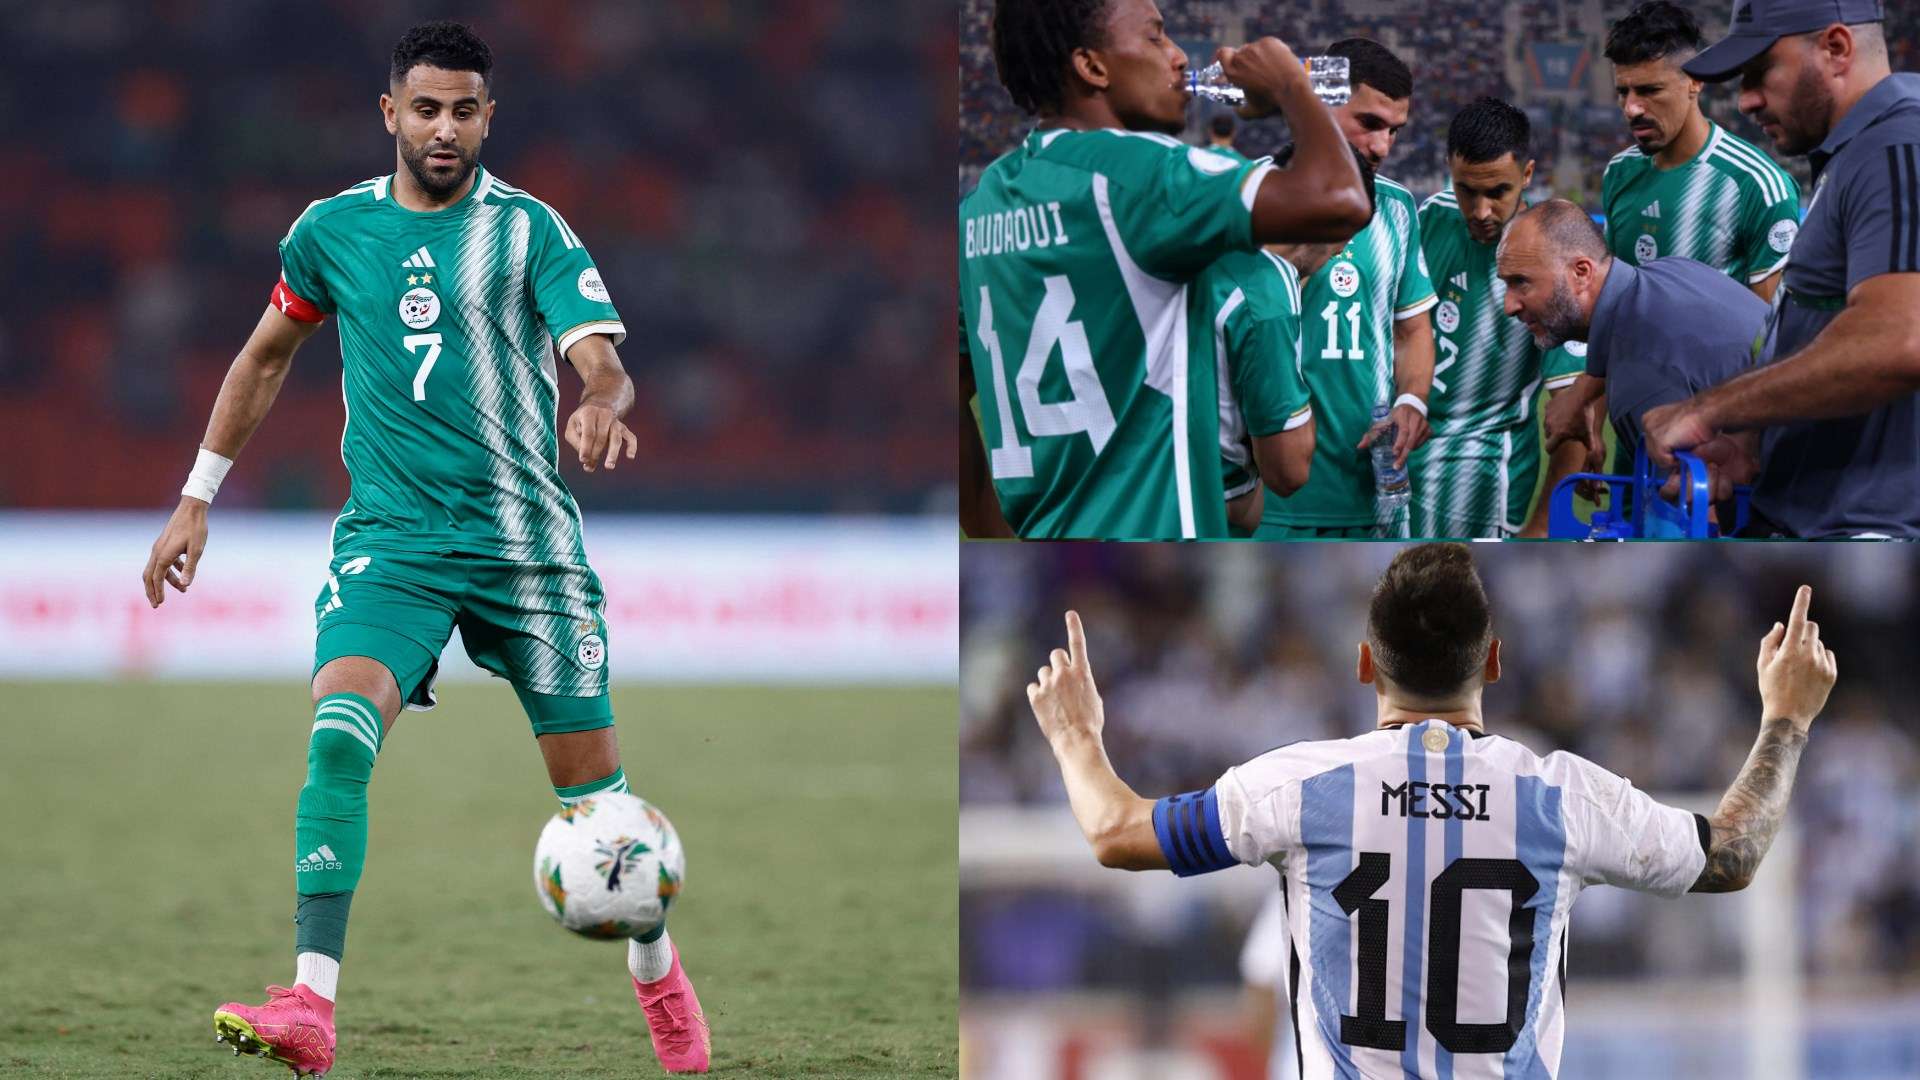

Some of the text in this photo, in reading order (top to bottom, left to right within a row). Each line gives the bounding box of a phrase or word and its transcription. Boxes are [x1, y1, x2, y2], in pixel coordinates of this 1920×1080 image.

[1321, 301, 1364, 360] 11
[1432, 329, 1459, 394] 2
[403, 332, 442, 401] 7
[977, 274, 1117, 480] 14
[1381, 780, 1490, 821] MESSI
[296, 860, 343, 873] adidas
[1331, 852, 1540, 1054] 10
